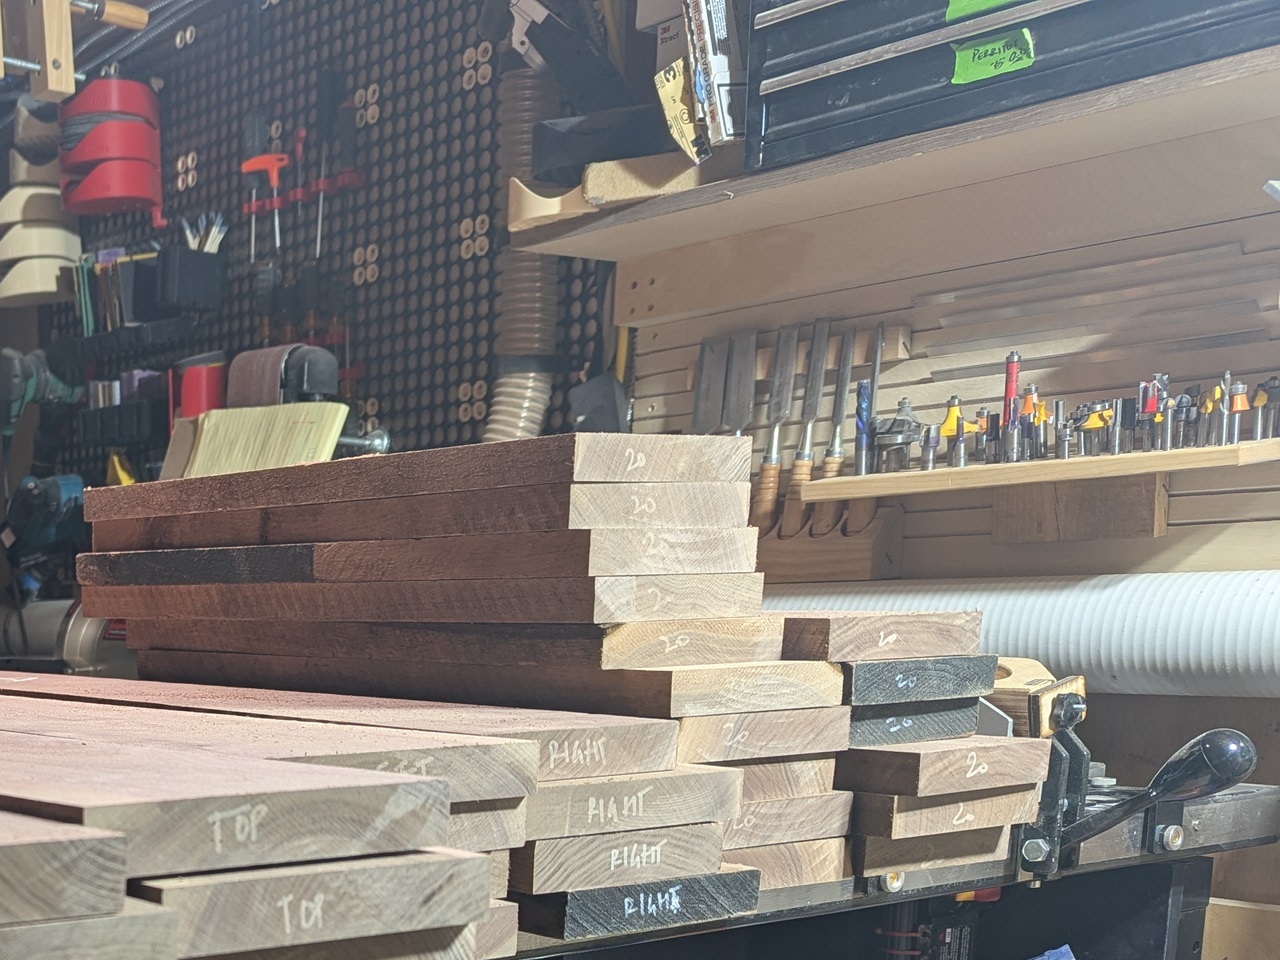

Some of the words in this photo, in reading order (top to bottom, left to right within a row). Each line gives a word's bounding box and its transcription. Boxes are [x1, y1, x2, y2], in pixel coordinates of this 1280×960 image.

[699, 45, 711, 83] GRADE
[704, 83, 713, 107] PRO
[625, 448, 646, 472] 20
[631, 495, 656, 514] 20
[659, 634, 690, 653] 20
[895, 673, 917, 688] 20
[548, 738, 607, 769] RIGHT
[966, 751, 989, 779] 20
[587, 785, 654, 823] RIGHT
[952, 802, 975, 826] 20
[207, 803, 269, 854] TOP
[610, 839, 668, 871] RIGHT
[276, 893, 326, 936] TOP
[623, 884, 683, 919] RIGHT
